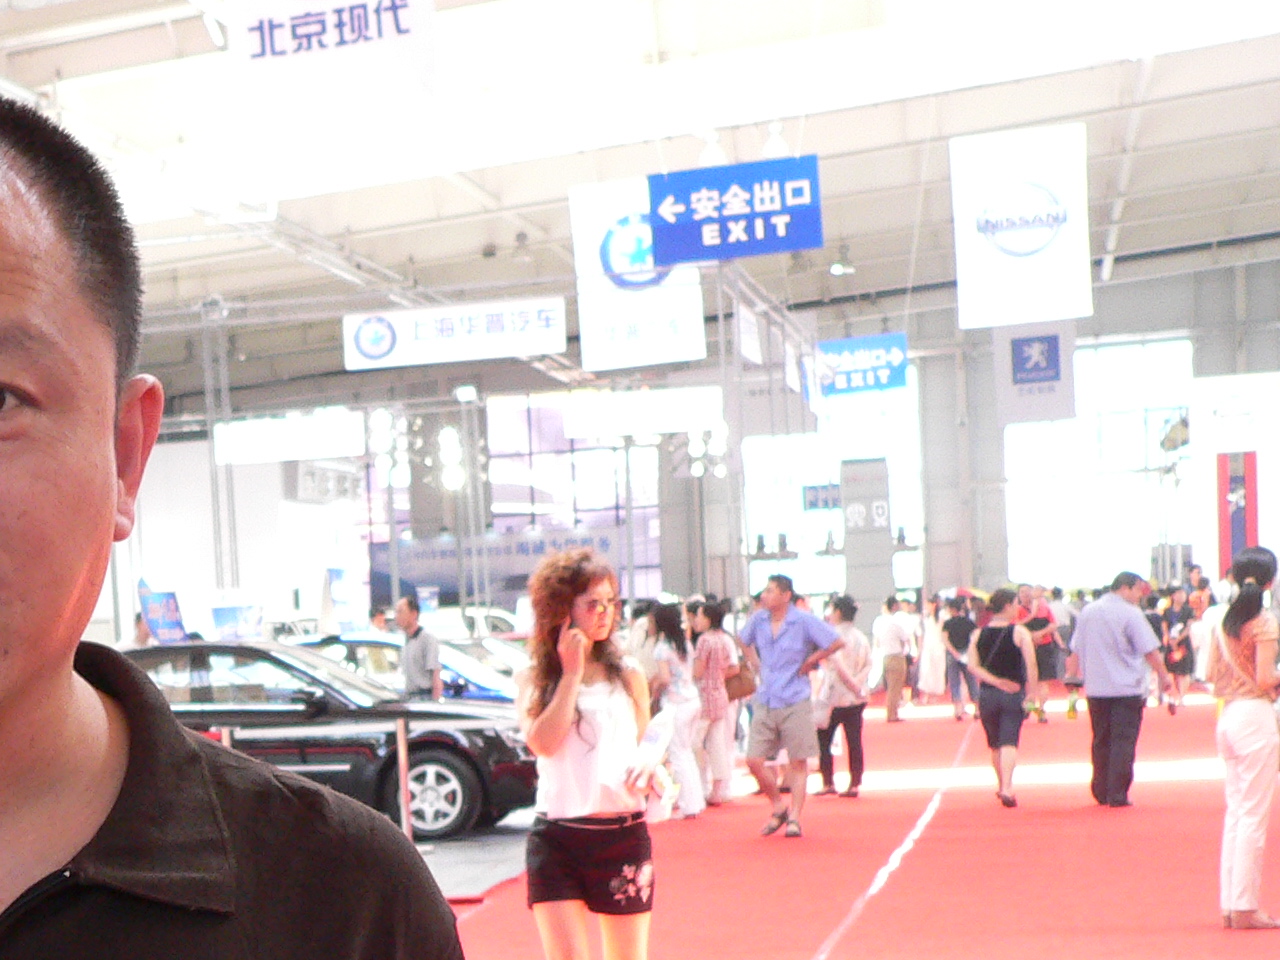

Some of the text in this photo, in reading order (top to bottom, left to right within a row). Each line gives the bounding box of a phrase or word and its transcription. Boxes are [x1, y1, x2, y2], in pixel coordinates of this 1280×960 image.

[247, 0, 411, 59] 北京现代
[690, 178, 812, 221] 安全出口
[701, 213, 791, 247] EXIT
[834, 367, 890, 389] EXIT
